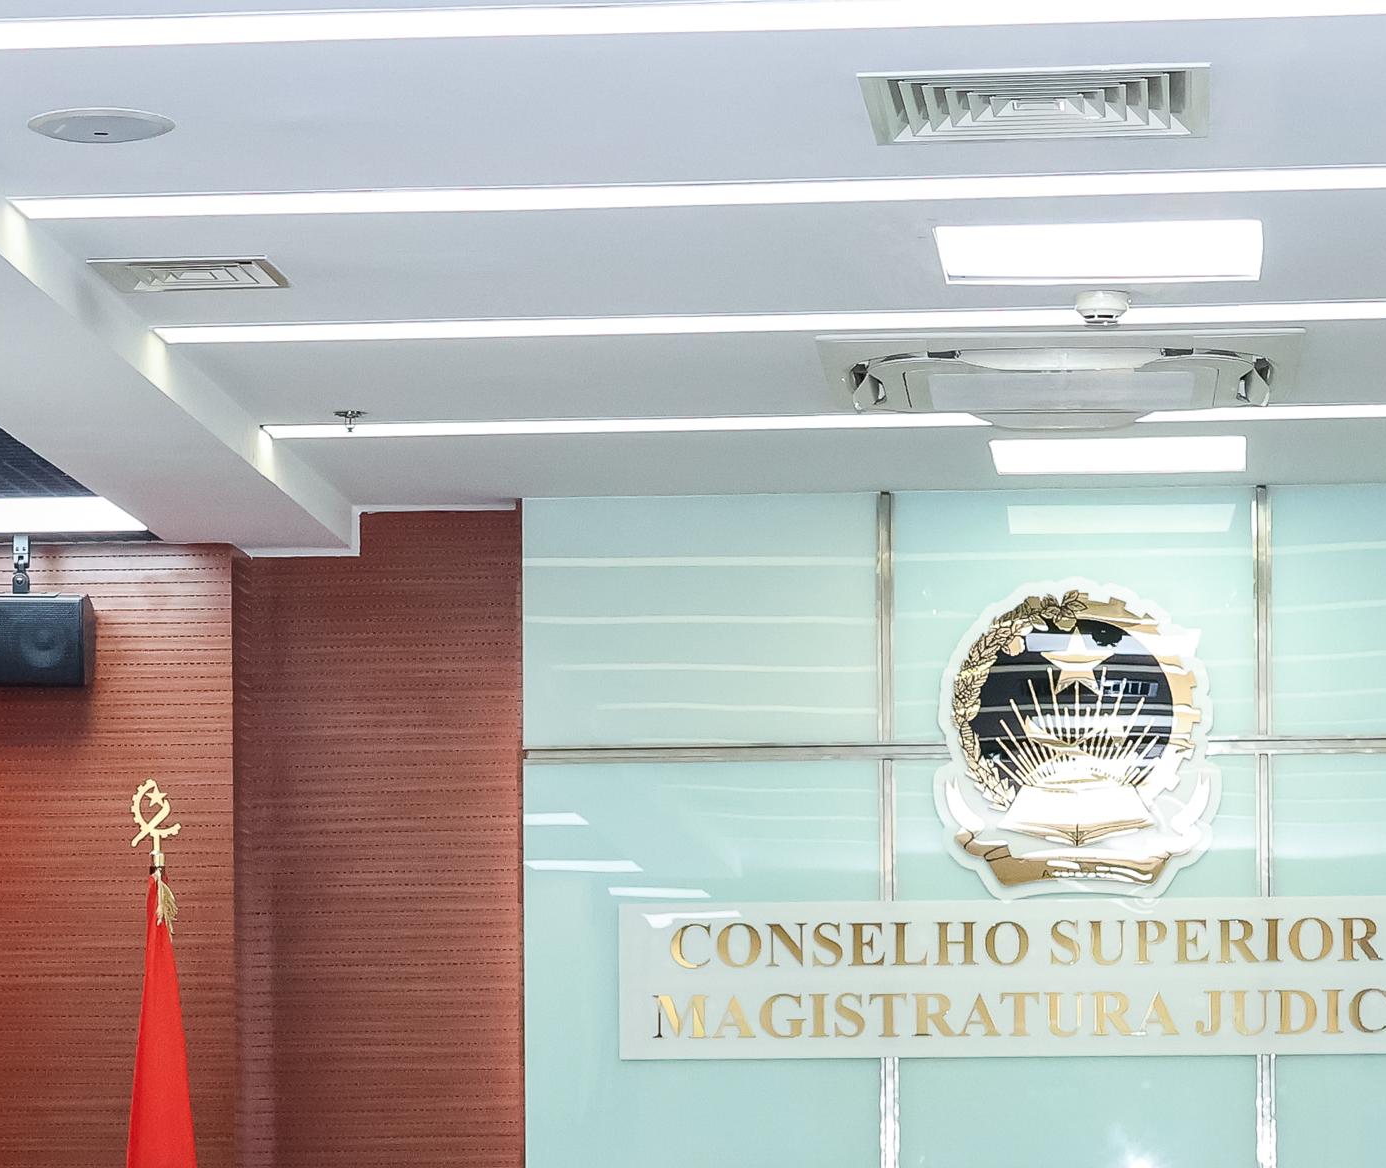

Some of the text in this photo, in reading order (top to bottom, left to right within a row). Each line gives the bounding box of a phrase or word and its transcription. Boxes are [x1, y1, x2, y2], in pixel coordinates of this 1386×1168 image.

[669, 920, 1029, 970] CONSELHO
[1050, 917, 1383, 967] SUPERIOR
[652, 990, 1180, 1041] MAGISTRATURA
